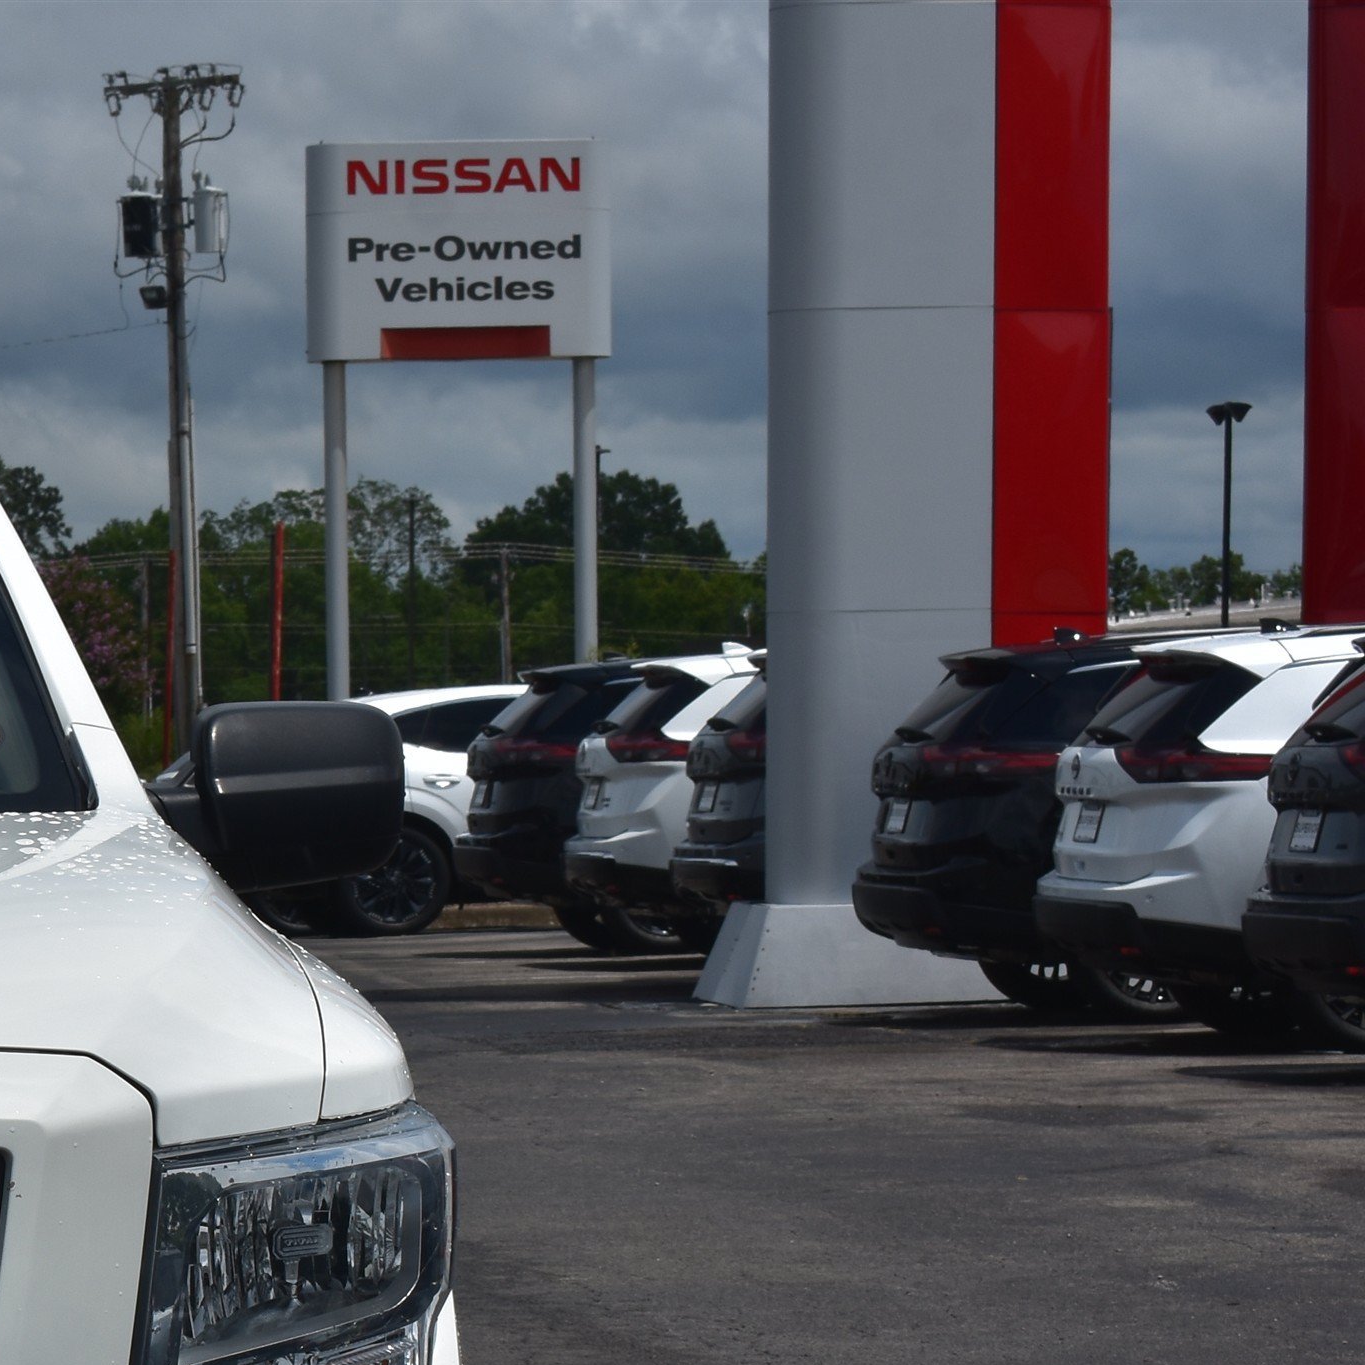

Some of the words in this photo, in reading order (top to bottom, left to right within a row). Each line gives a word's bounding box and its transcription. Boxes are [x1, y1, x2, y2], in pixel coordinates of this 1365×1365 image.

[346, 157, 581, 195] NISSAN
[347, 234, 582, 263] Pre-Owned
[375, 275, 555, 303] Vehicles
